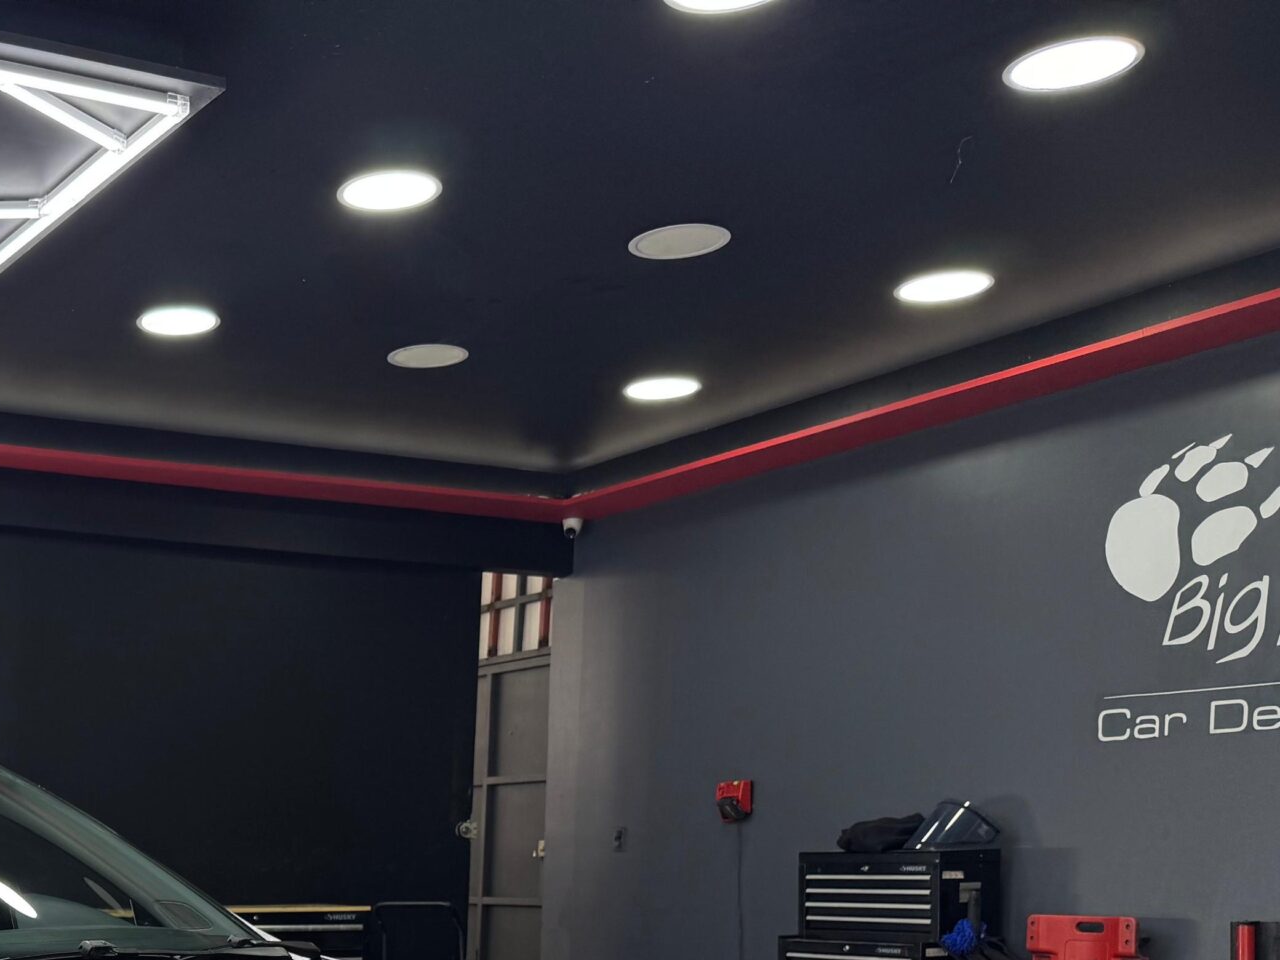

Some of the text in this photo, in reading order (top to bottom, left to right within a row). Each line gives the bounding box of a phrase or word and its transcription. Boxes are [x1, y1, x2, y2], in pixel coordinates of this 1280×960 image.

[1162, 572, 1270, 664] Big
[1097, 707, 1187, 742] Car
[332, 913, 357, 921] HUSKY
